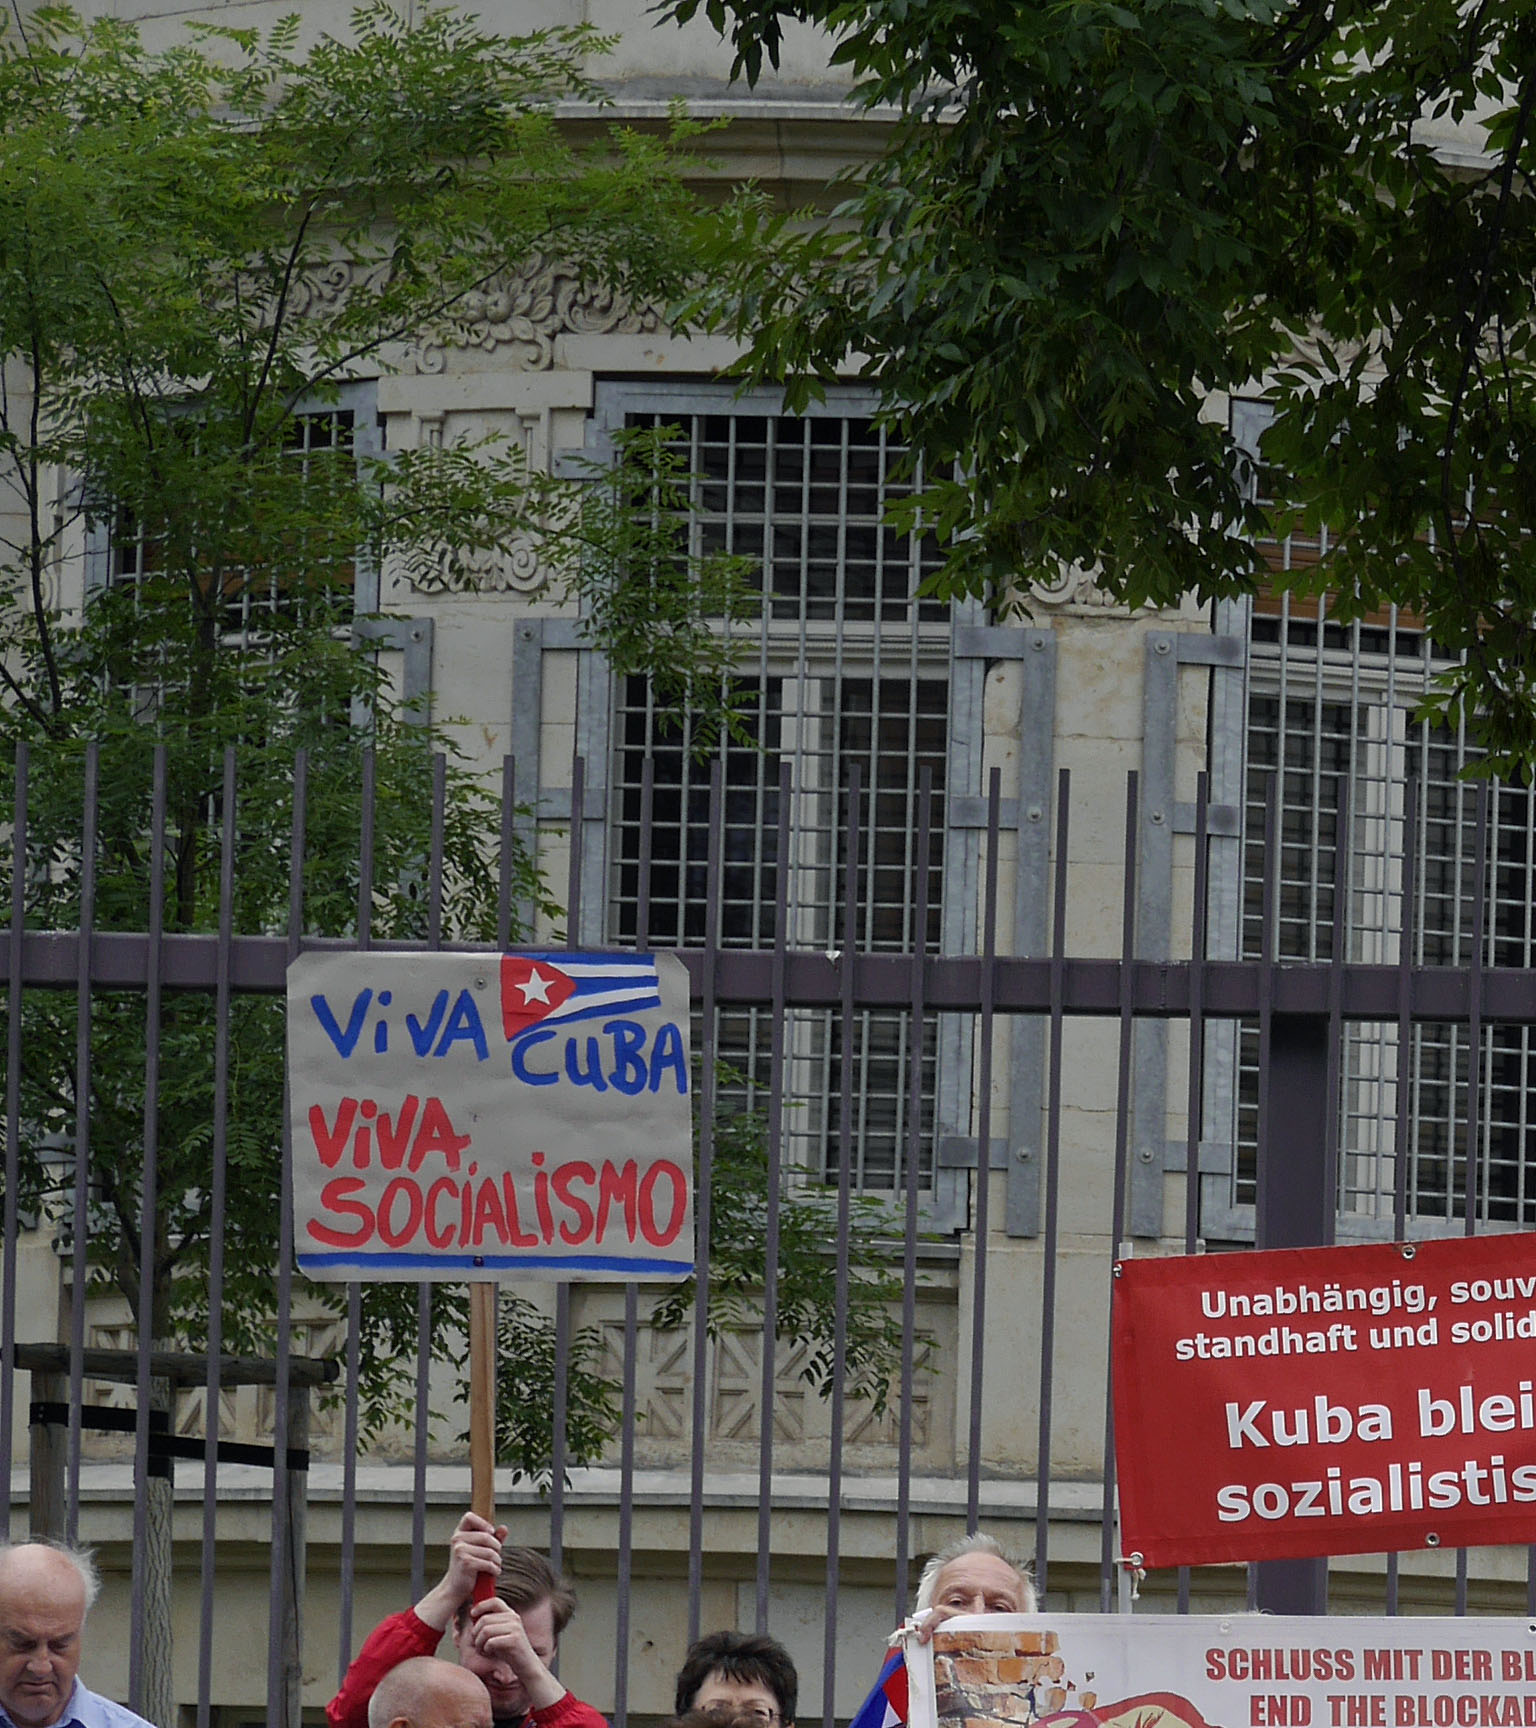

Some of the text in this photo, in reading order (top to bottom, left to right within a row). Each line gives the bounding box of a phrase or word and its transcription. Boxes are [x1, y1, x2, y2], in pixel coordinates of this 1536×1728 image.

[1201, 1279, 1438, 1319] Unabhängig,
[1175, 1322, 1358, 1361] standhaft
[1369, 1316, 1439, 1350] und
[1224, 1394, 1394, 1449] Kuba
[1205, 1647, 1355, 1681] SCHLUSS
[1363, 1648, 1424, 1681] MIT
[1431, 1649, 1493, 1682] DER
[1249, 1695, 1312, 1727] END
[1326, 1695, 1387, 1727] THE
